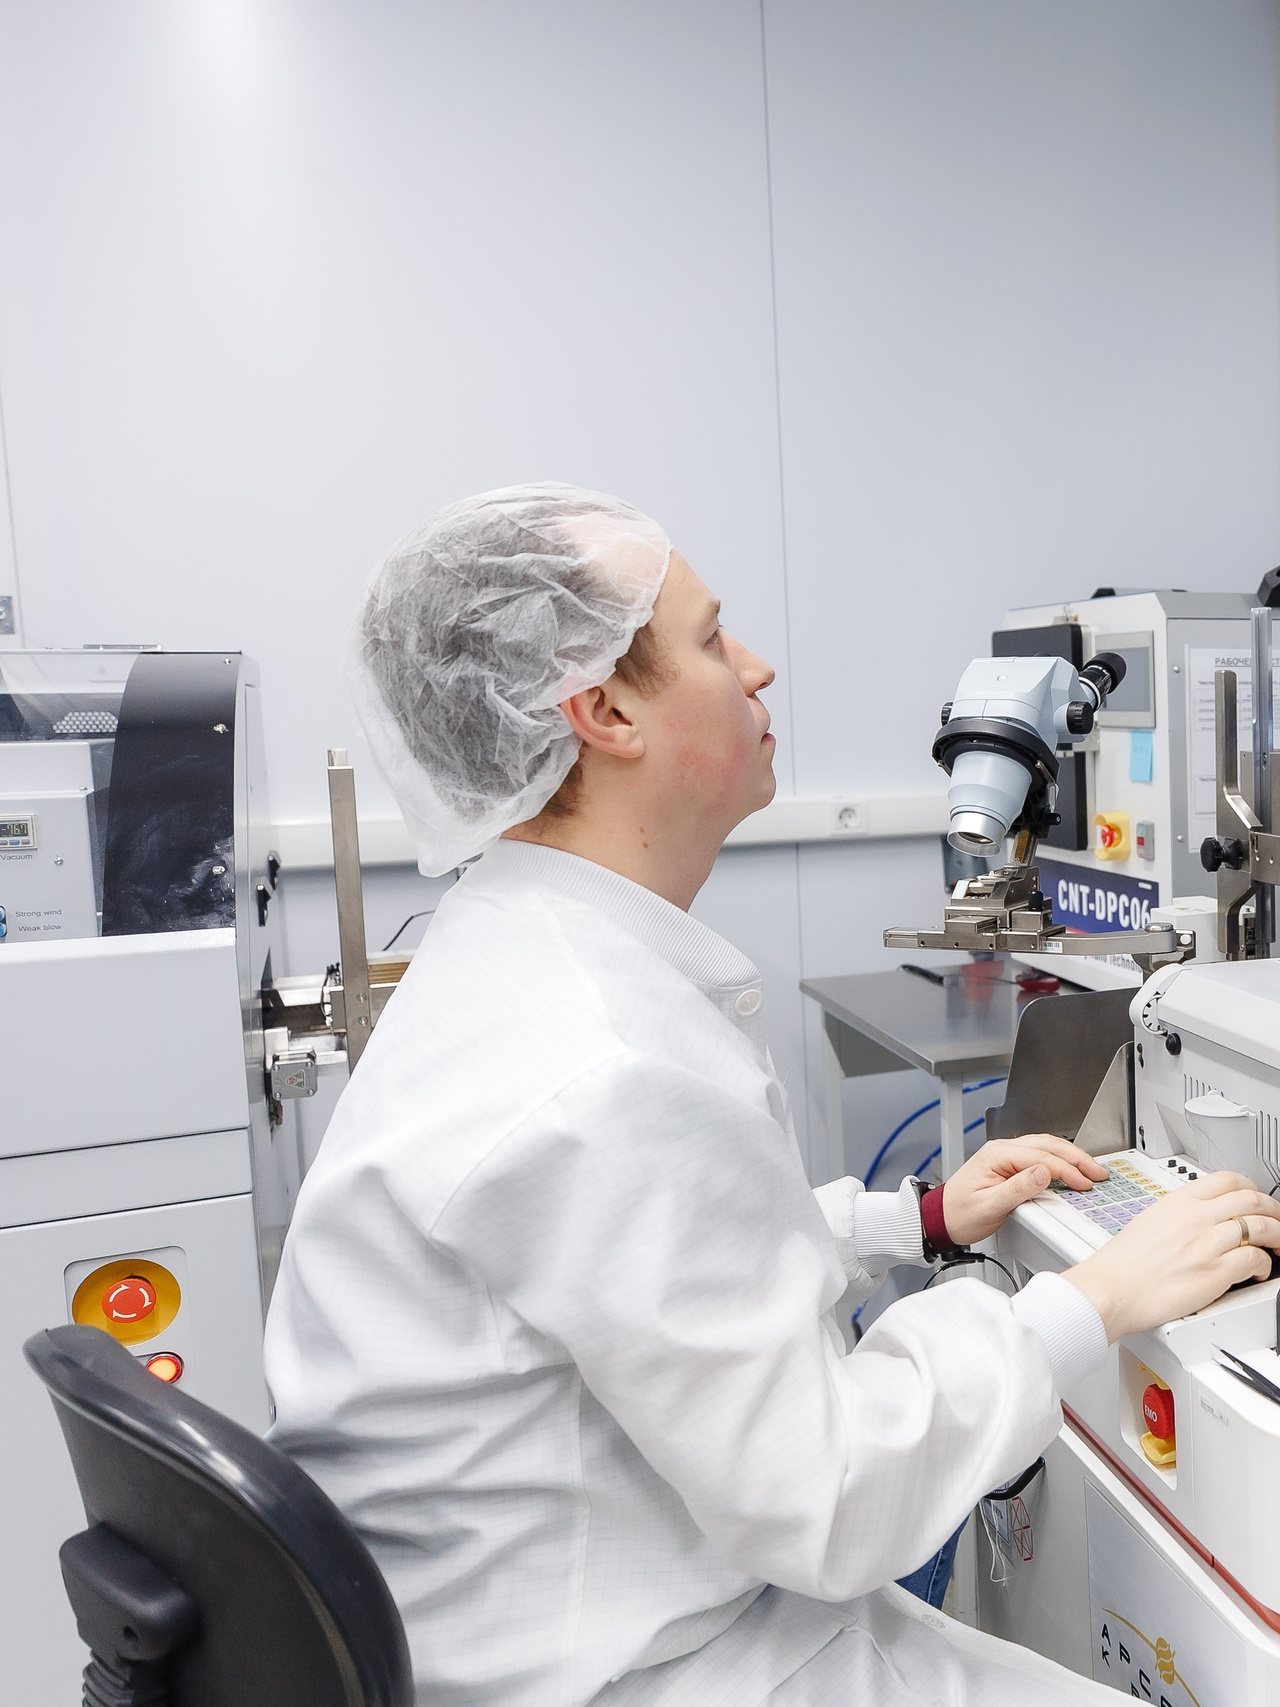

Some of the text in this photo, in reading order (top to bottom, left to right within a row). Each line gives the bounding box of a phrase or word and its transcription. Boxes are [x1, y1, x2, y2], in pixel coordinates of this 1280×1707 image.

[15, 910, 42, 918] Strong
[1058, 879, 1151, 930] CNT-DPC06
[1144, 1404, 1158, 1423] EMO
